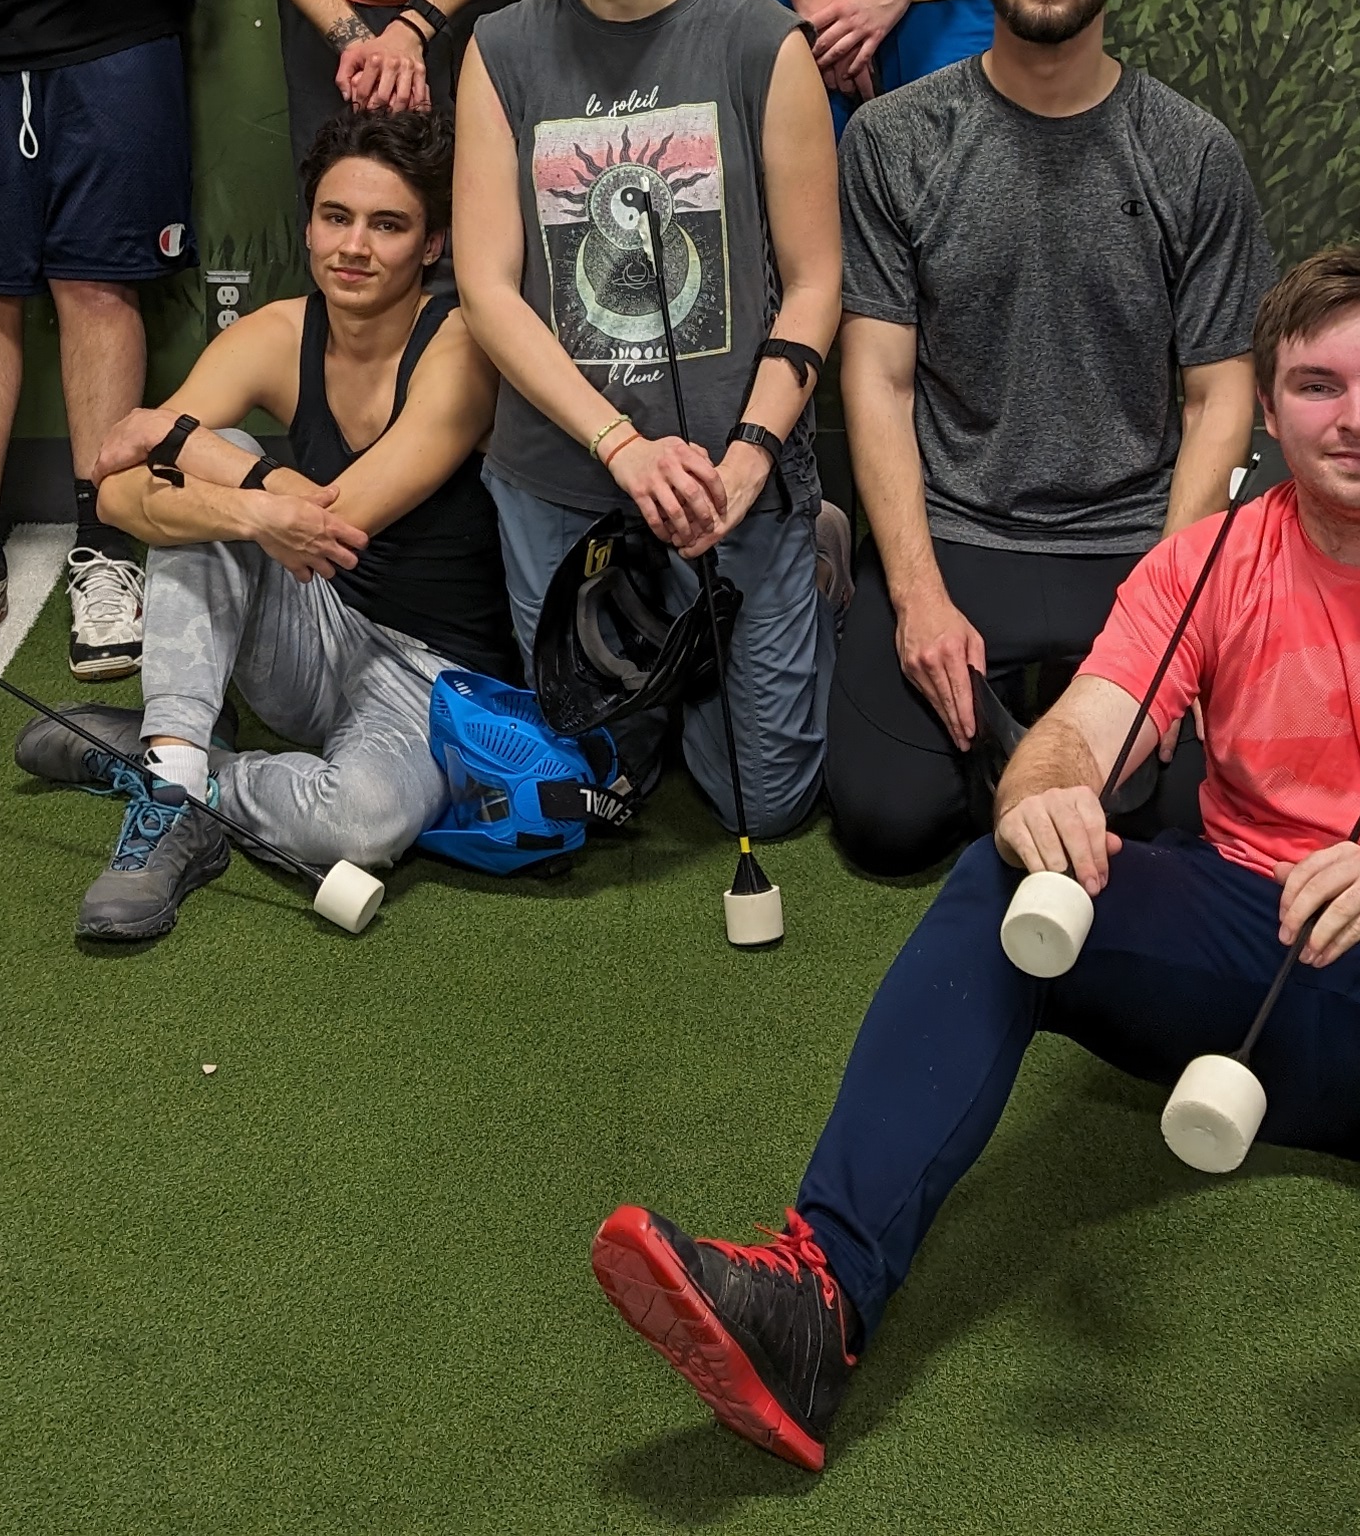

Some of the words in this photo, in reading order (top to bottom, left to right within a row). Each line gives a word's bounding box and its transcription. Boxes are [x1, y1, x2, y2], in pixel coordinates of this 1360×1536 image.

[585, 93, 603, 116] le
[608, 85, 659, 119] soleil
[623, 363, 665, 386] lune
